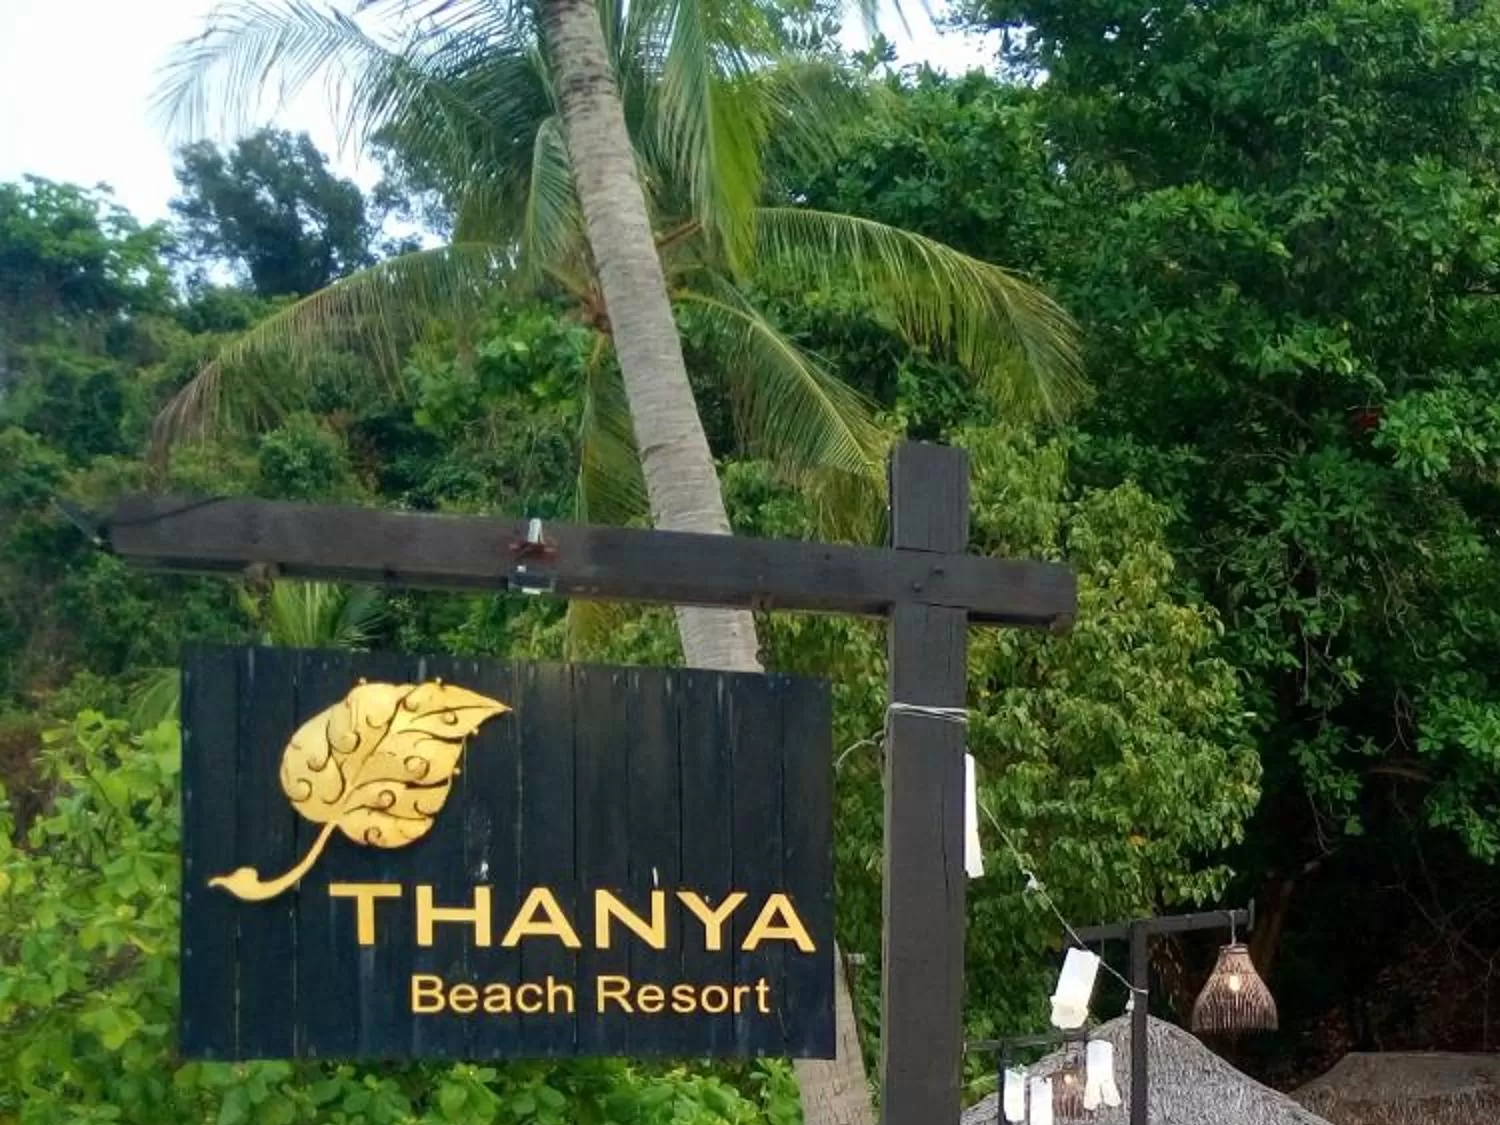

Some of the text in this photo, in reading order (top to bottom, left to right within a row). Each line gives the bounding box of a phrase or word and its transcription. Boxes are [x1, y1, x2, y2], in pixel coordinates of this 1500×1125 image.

[328, 883, 816, 952] THANYA
[411, 974, 769, 1013] Beach Resort
